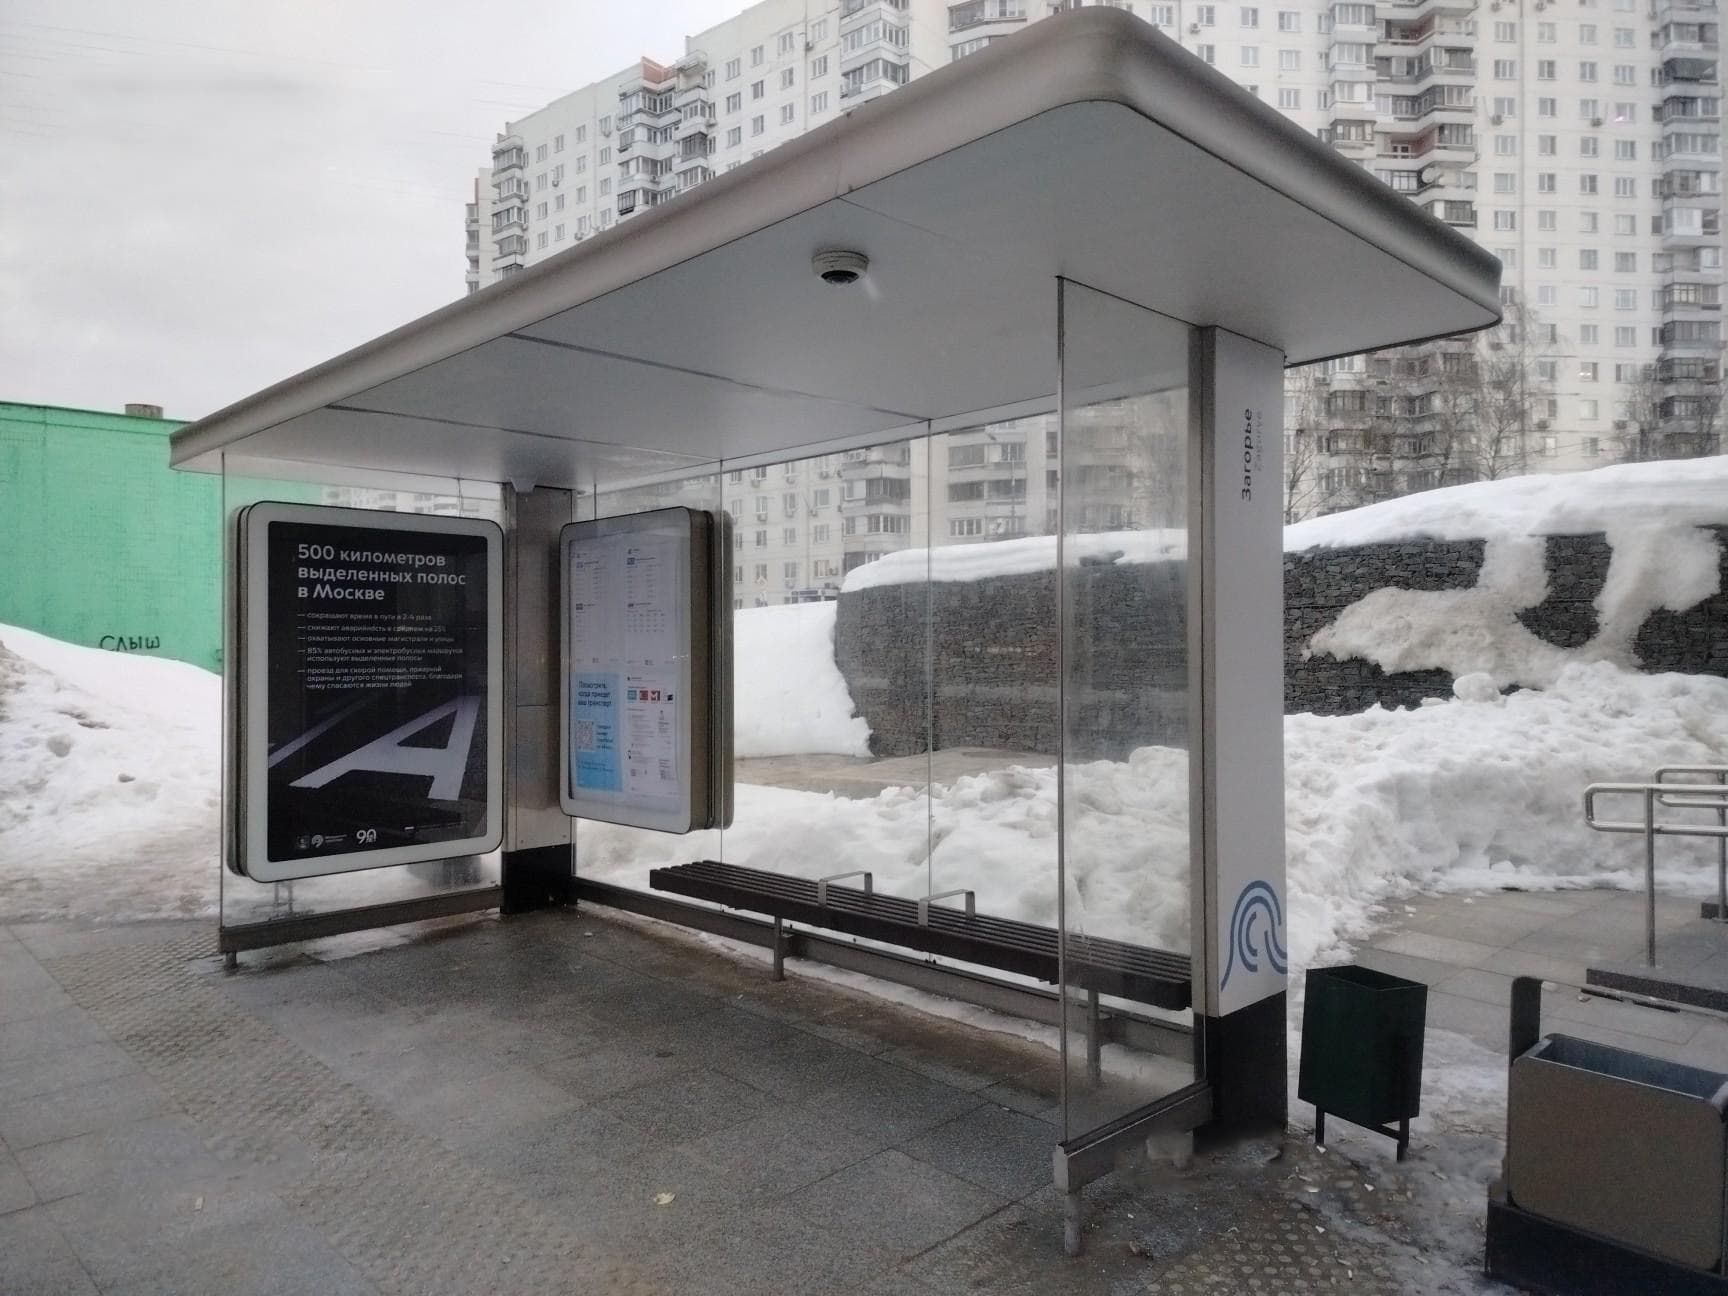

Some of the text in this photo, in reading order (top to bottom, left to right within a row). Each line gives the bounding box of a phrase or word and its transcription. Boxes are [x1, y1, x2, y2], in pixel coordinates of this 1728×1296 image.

[1241, 408, 1253, 503] Загорье
[298, 544, 446, 568] 500 километров
[298, 567, 466, 585] выделенных полос
[298, 584, 385, 600] в Москве
[356, 828, 377, 844] 90
